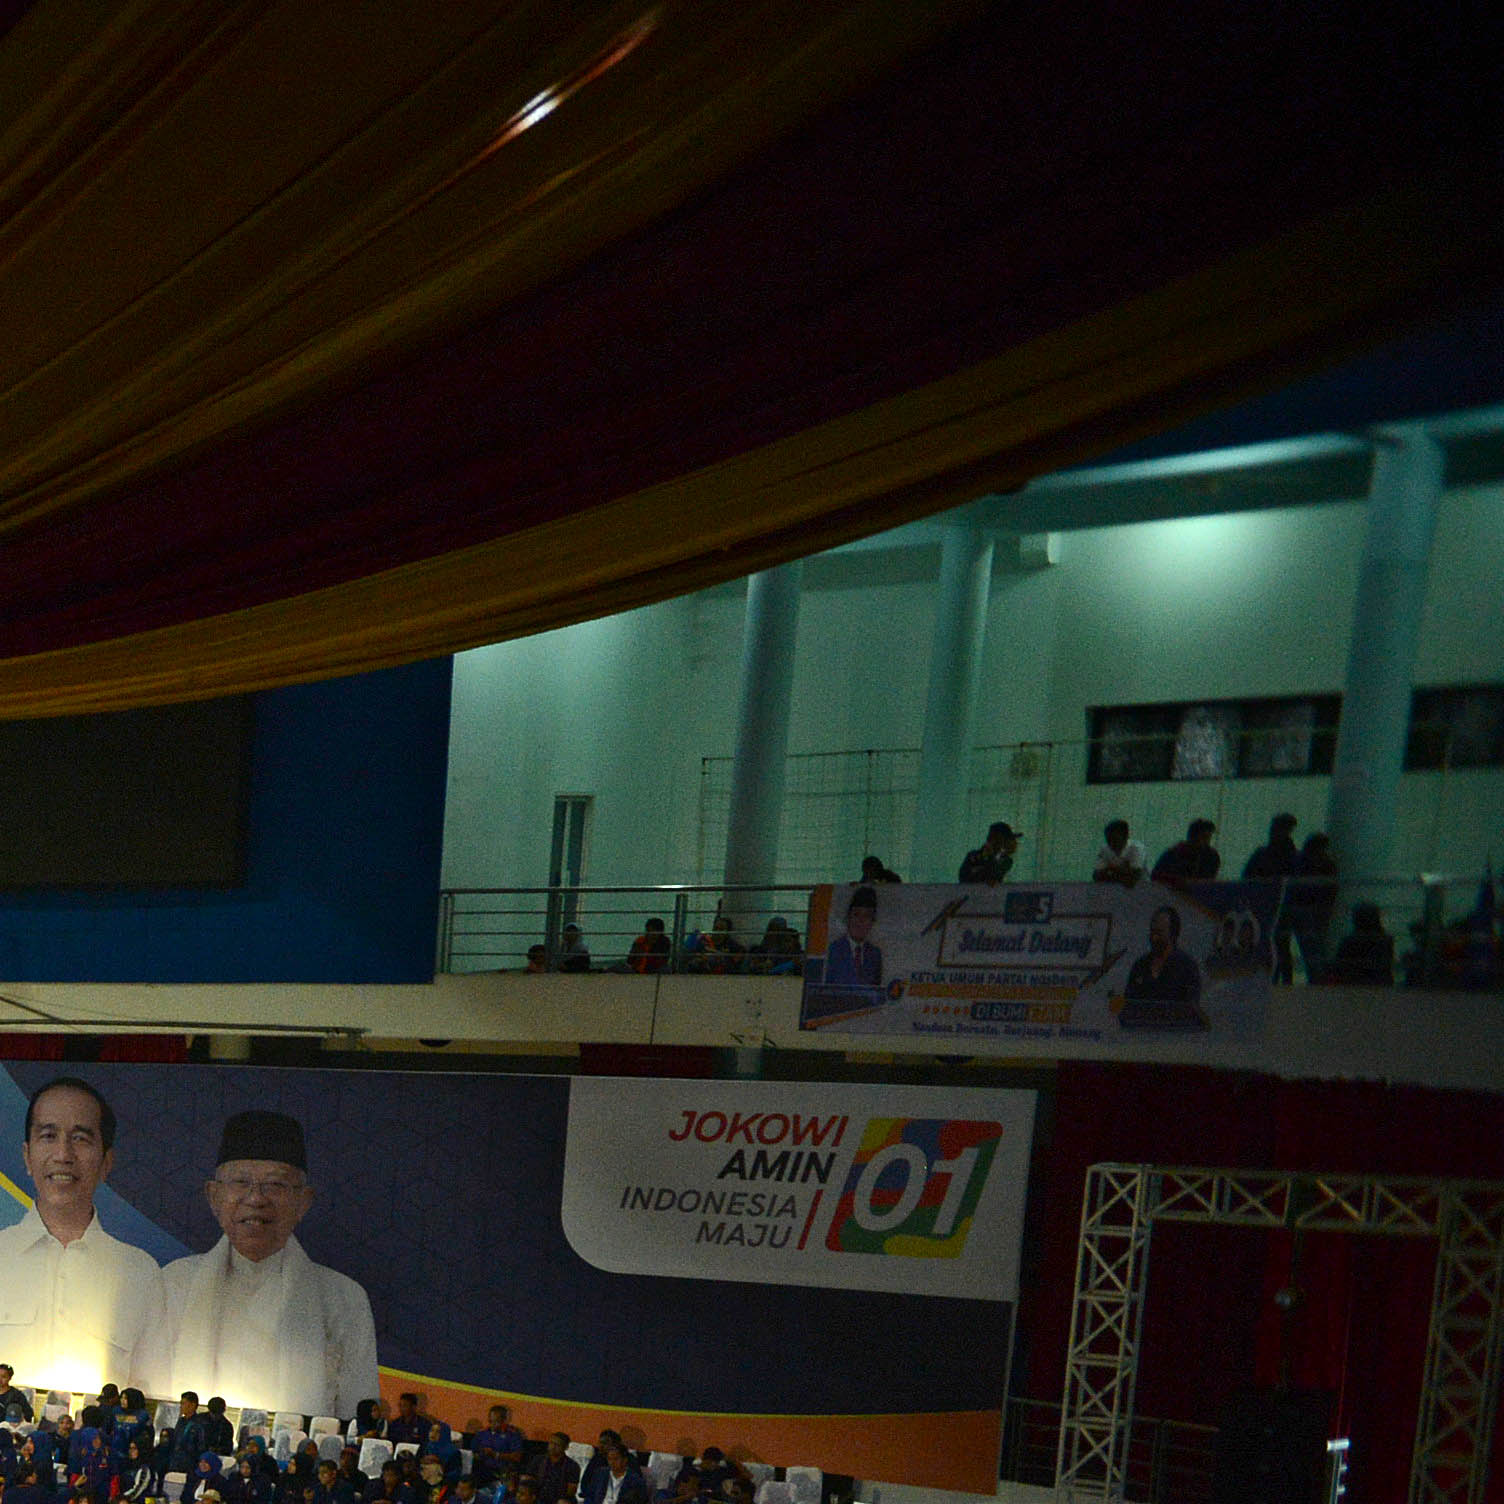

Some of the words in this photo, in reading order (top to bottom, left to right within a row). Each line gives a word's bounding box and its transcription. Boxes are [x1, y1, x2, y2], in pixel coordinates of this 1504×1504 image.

[668, 1110, 849, 1147] JOKOWI
[717, 1149, 836, 1184] AMIN
[619, 1186, 798, 1219] INDONESIA
[853, 1142, 981, 1235] 01
[695, 1221, 793, 1250] MAJU
